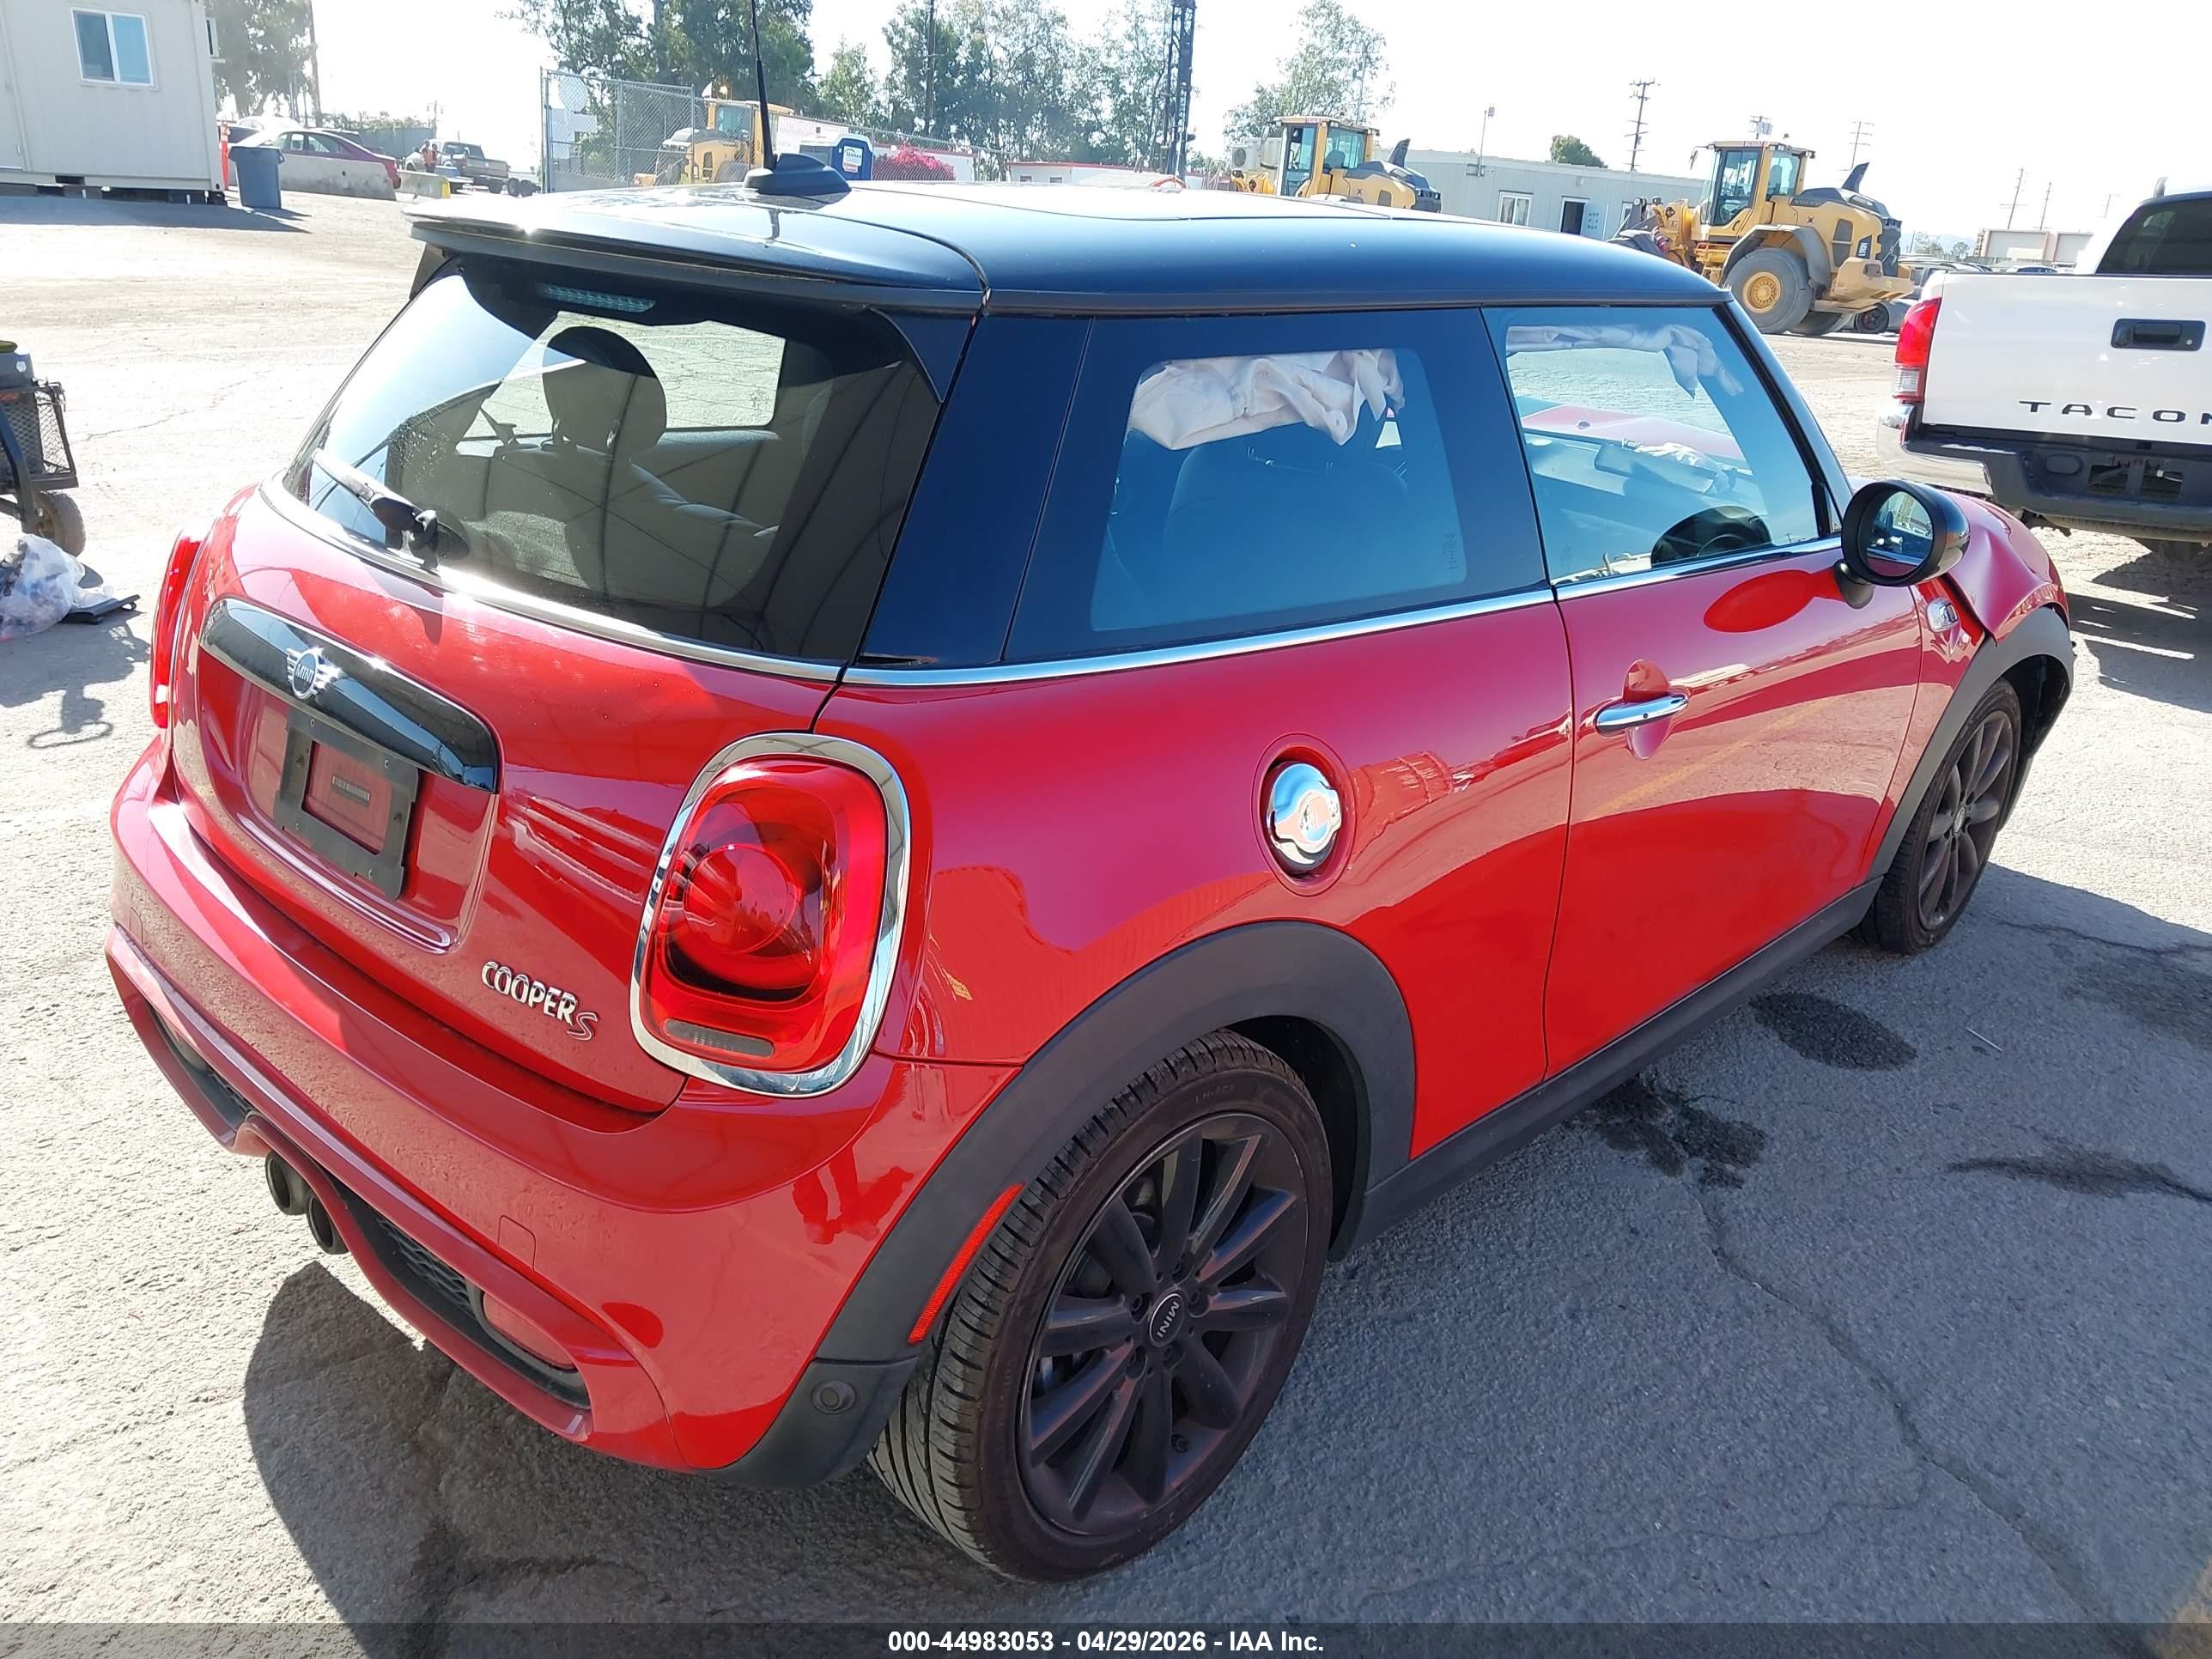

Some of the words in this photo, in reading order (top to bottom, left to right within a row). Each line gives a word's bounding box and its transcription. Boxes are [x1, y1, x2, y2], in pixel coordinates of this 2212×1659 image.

[295, 663, 315, 684] MINI
[481, 961, 578, 1026] COOPER
[566, 1012, 599, 1042] S
[1157, 1301, 1180, 1338] MINI
